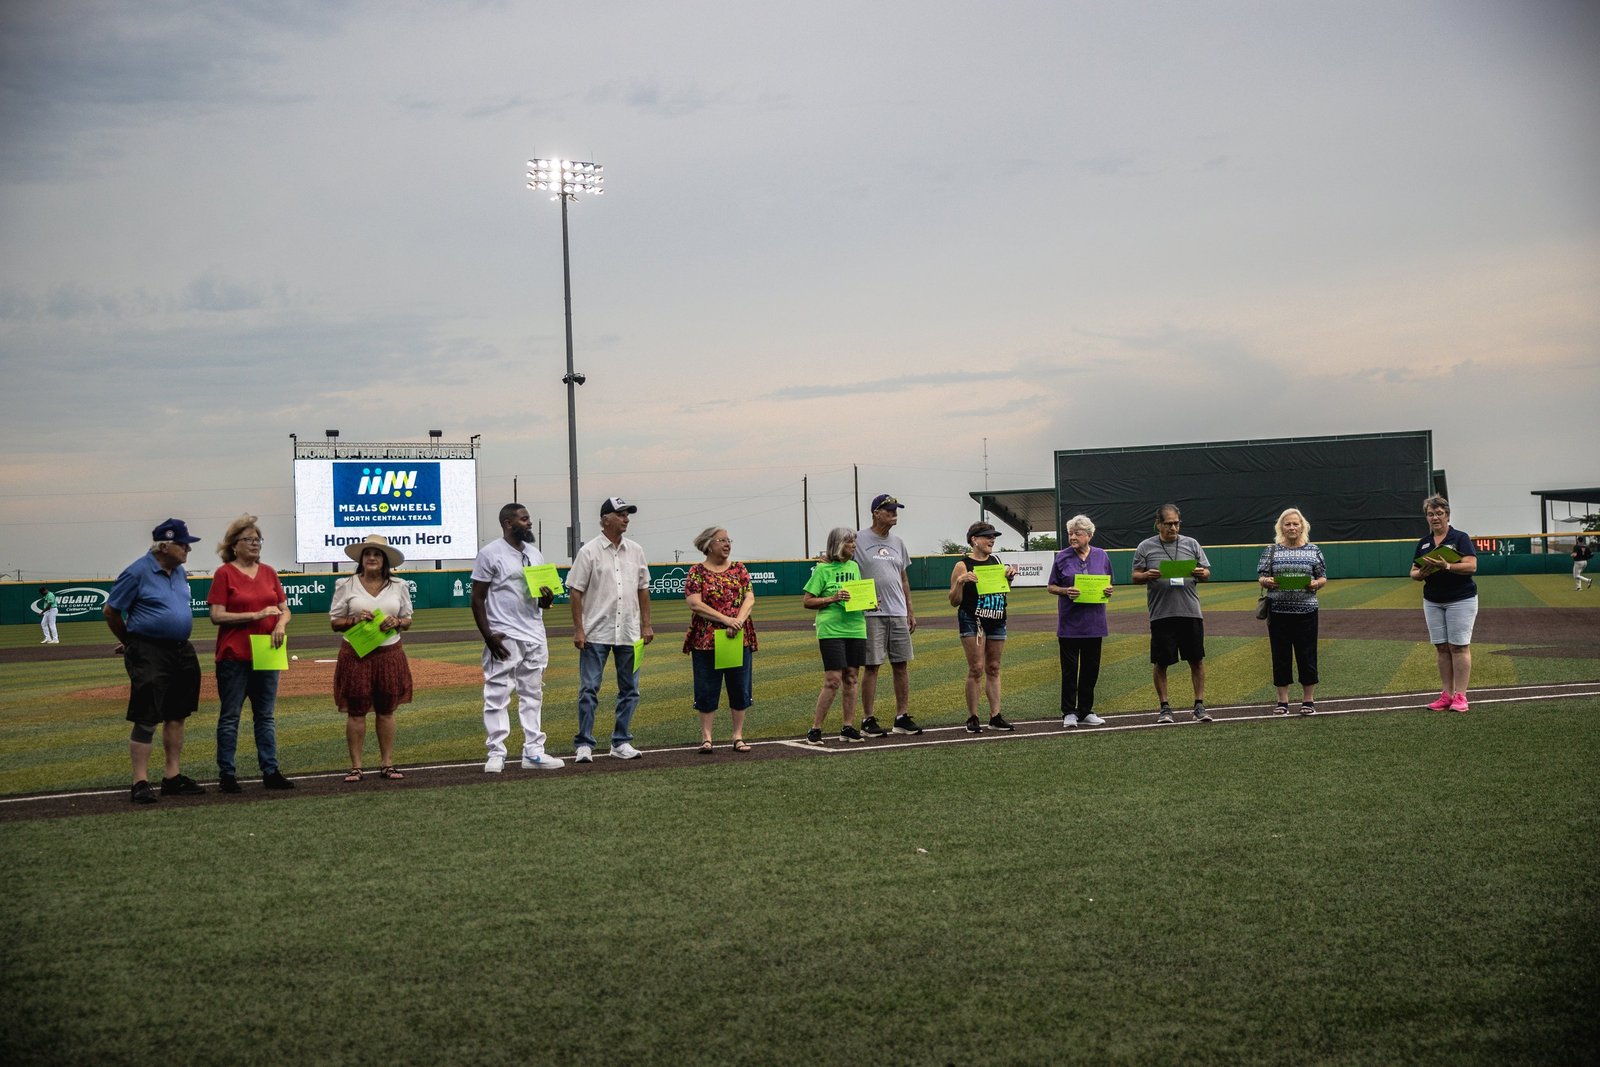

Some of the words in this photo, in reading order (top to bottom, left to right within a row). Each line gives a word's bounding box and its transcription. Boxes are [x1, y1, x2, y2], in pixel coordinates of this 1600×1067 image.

[297, 448, 336, 459] HOME
[337, 448, 355, 459] OF
[358, 448, 386, 459] THE
[388, 448, 473, 459] RAILROADERS
[338, 503, 378, 512] MEALS
[389, 502, 436, 512] WHEELS
[415, 532, 452, 545] Hero
[1476, 539, 1496, 551] 441
[748, 571, 775, 579] rmon
[280, 580, 326, 594] nnacle
[55, 595, 98, 604] NGLAND
[285, 593, 304, 606] nk
